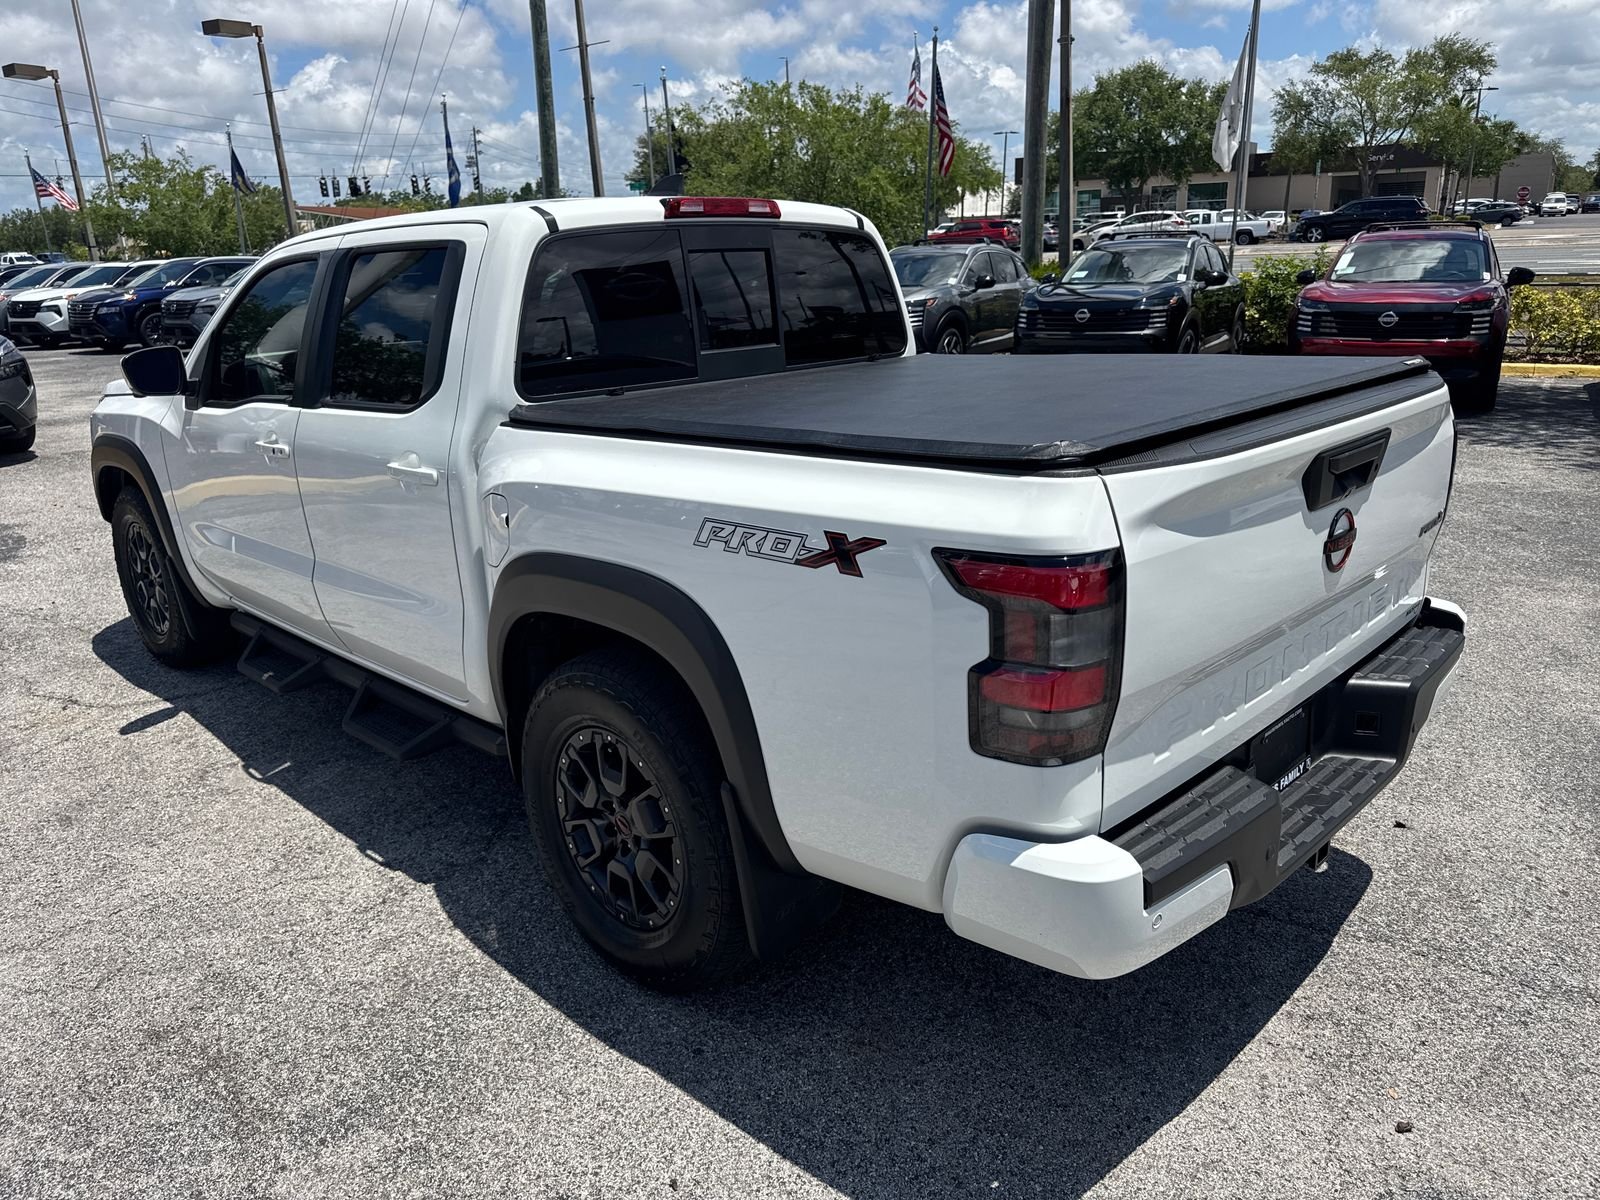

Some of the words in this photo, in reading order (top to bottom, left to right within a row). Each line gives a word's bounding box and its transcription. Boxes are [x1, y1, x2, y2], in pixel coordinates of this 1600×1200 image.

[1368, 153, 1395, 162] Serve
[693, 517, 887, 578] PRO-X
[1280, 761, 1305, 790] FAMILY
